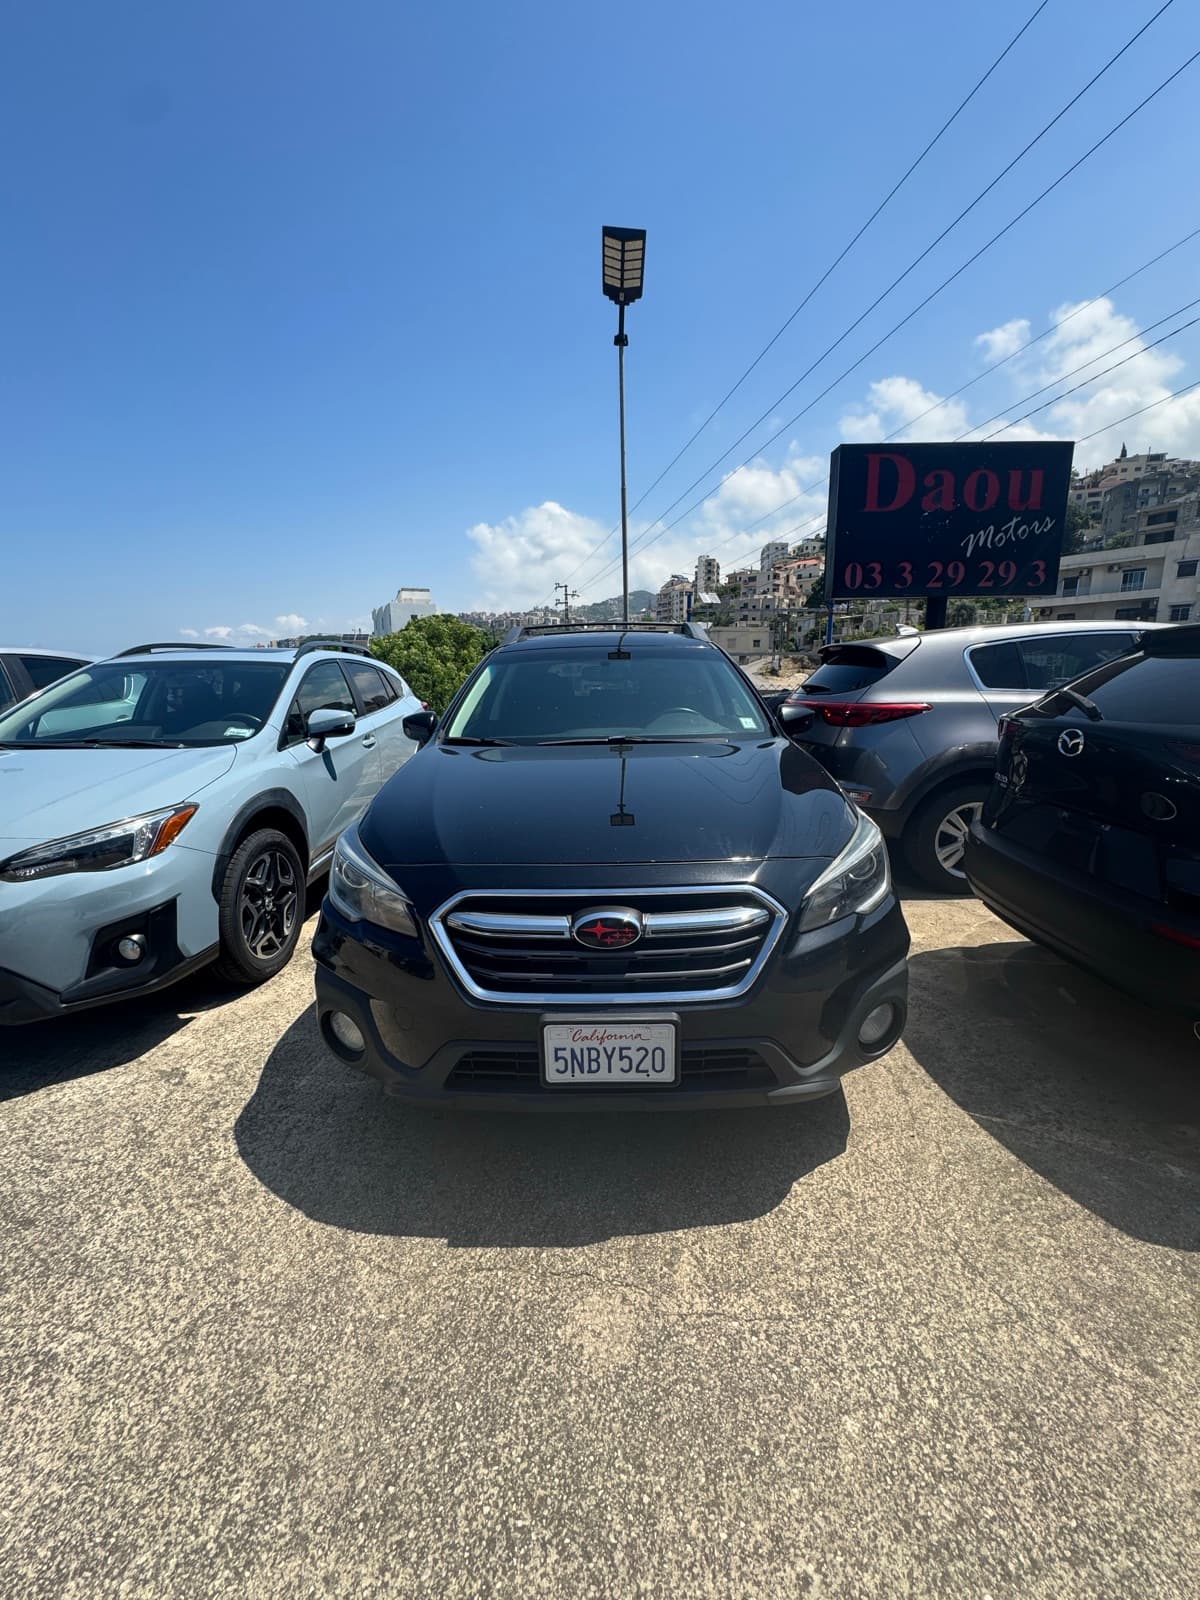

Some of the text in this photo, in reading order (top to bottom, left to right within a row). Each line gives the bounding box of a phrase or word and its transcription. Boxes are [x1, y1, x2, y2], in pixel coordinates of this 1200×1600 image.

[863, 453, 1045, 512] Daou
[960, 515, 1056, 558] Motors
[844, 559, 1047, 590] 03 3 29 29 3
[571, 1028, 651, 1045] California
[553, 1046, 666, 1074] 5NBY520
